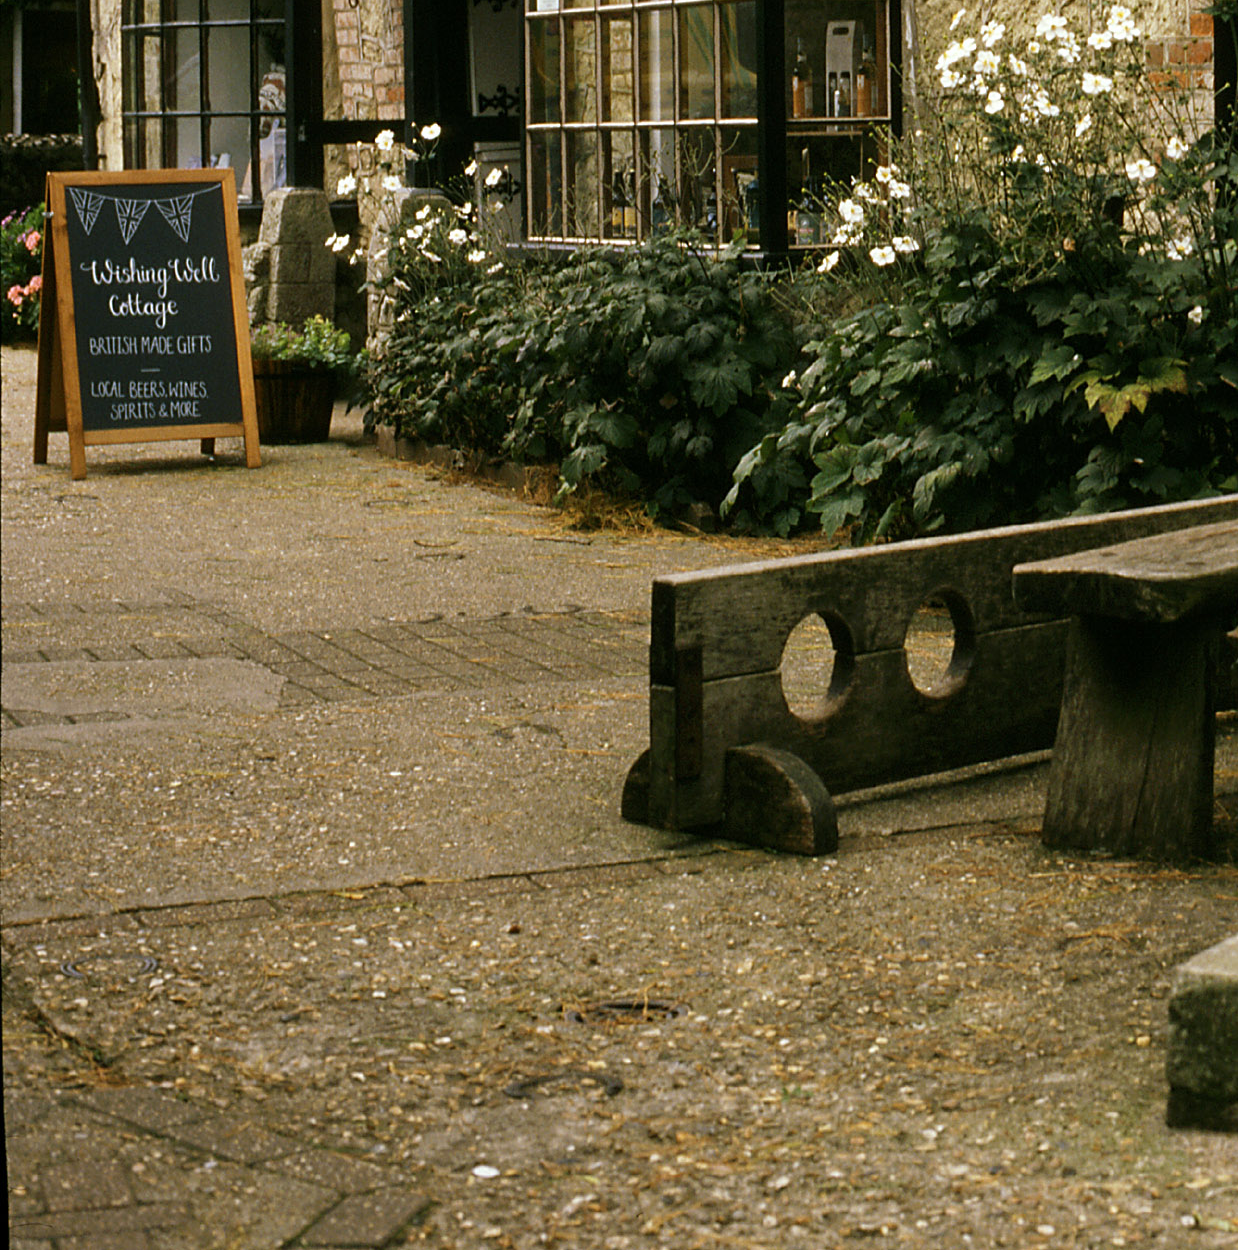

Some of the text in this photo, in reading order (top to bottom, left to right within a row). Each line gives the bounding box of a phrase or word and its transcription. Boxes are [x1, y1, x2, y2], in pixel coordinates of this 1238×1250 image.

[80, 255, 220, 299] Wishing Well
[109, 292, 179, 330] Cottage
[89, 335, 212, 356] BRITISH MADE GIFTS
[91, 381, 125, 398] LOCAL
[110, 402, 156, 421] SPIRITS
[158, 403, 169, 418] &
